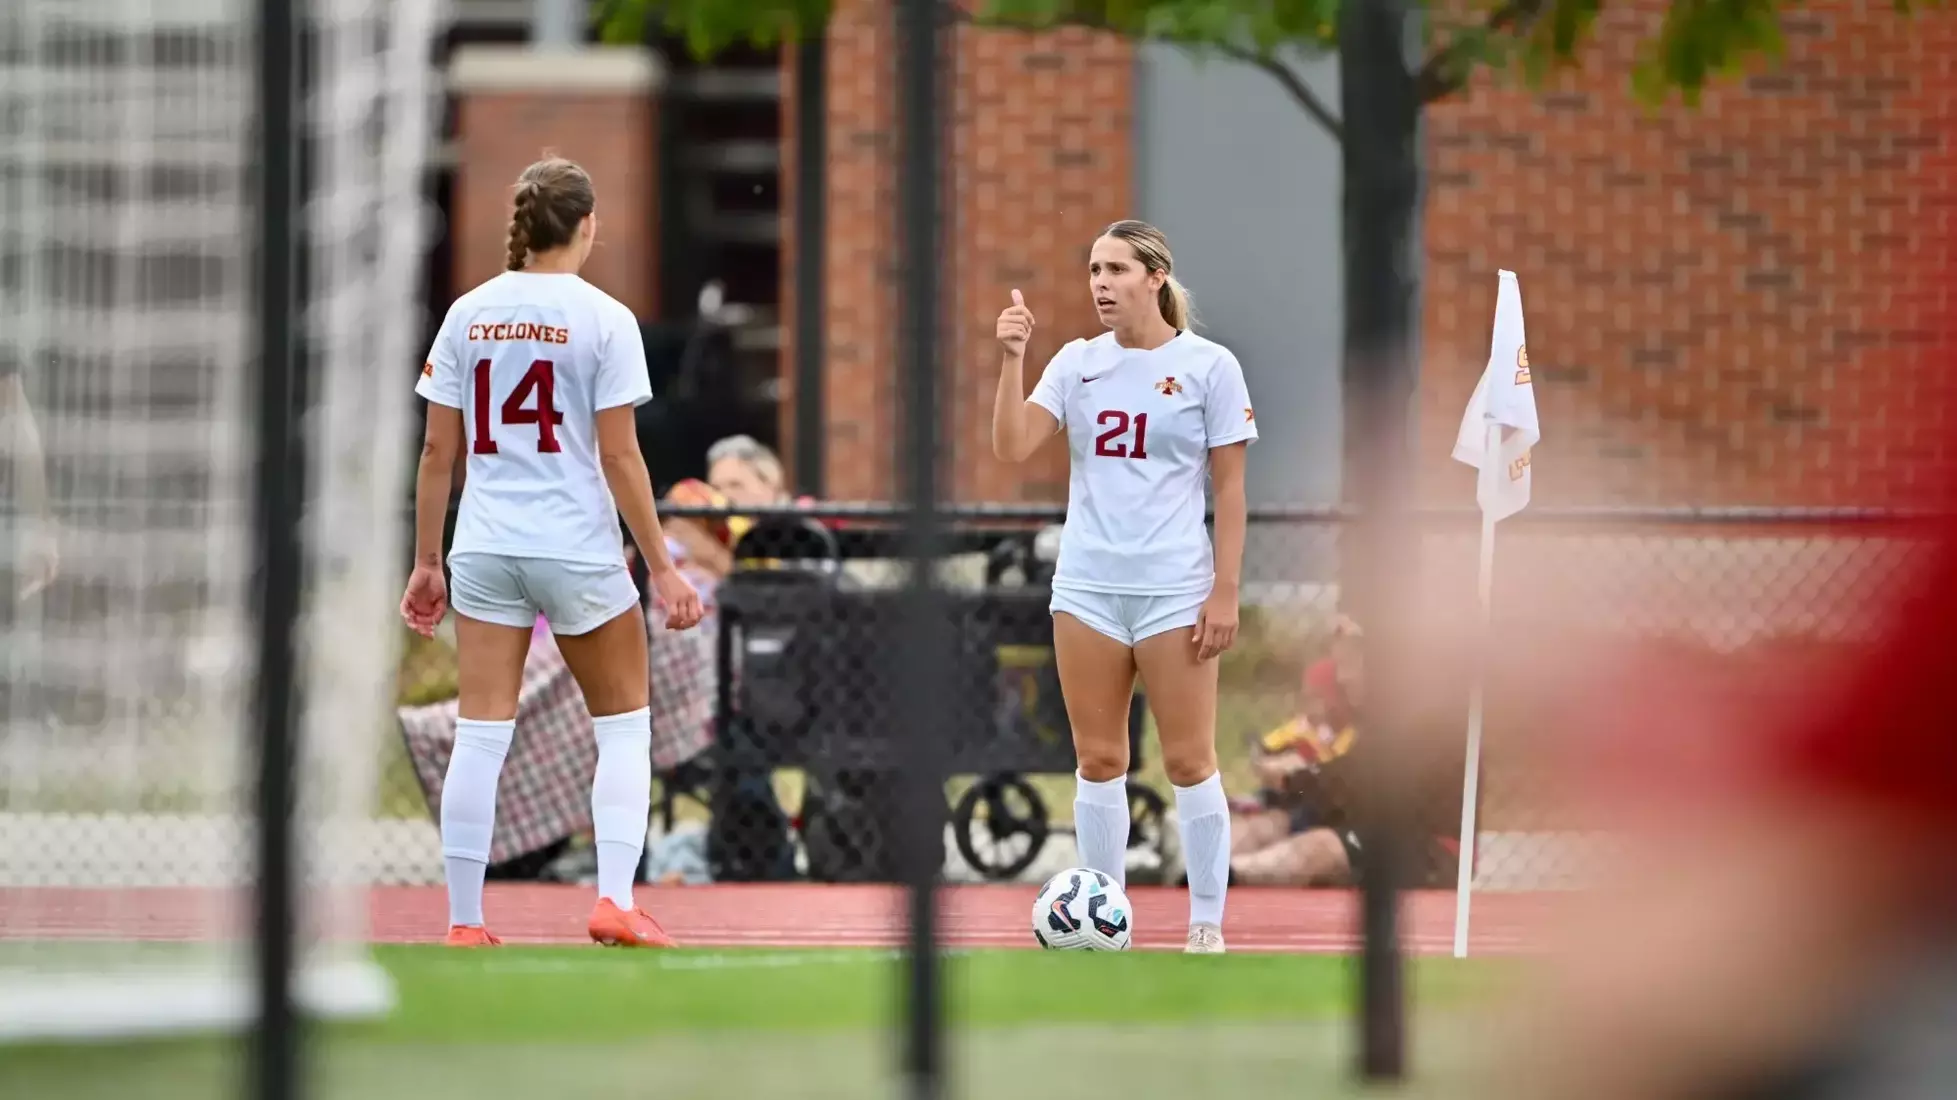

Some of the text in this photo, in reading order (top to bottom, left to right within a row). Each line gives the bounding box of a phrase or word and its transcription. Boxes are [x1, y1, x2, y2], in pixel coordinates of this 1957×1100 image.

[468, 323, 569, 344] CYCLONES
[473, 359, 564, 455] 14
[1095, 410, 1148, 460] 21
